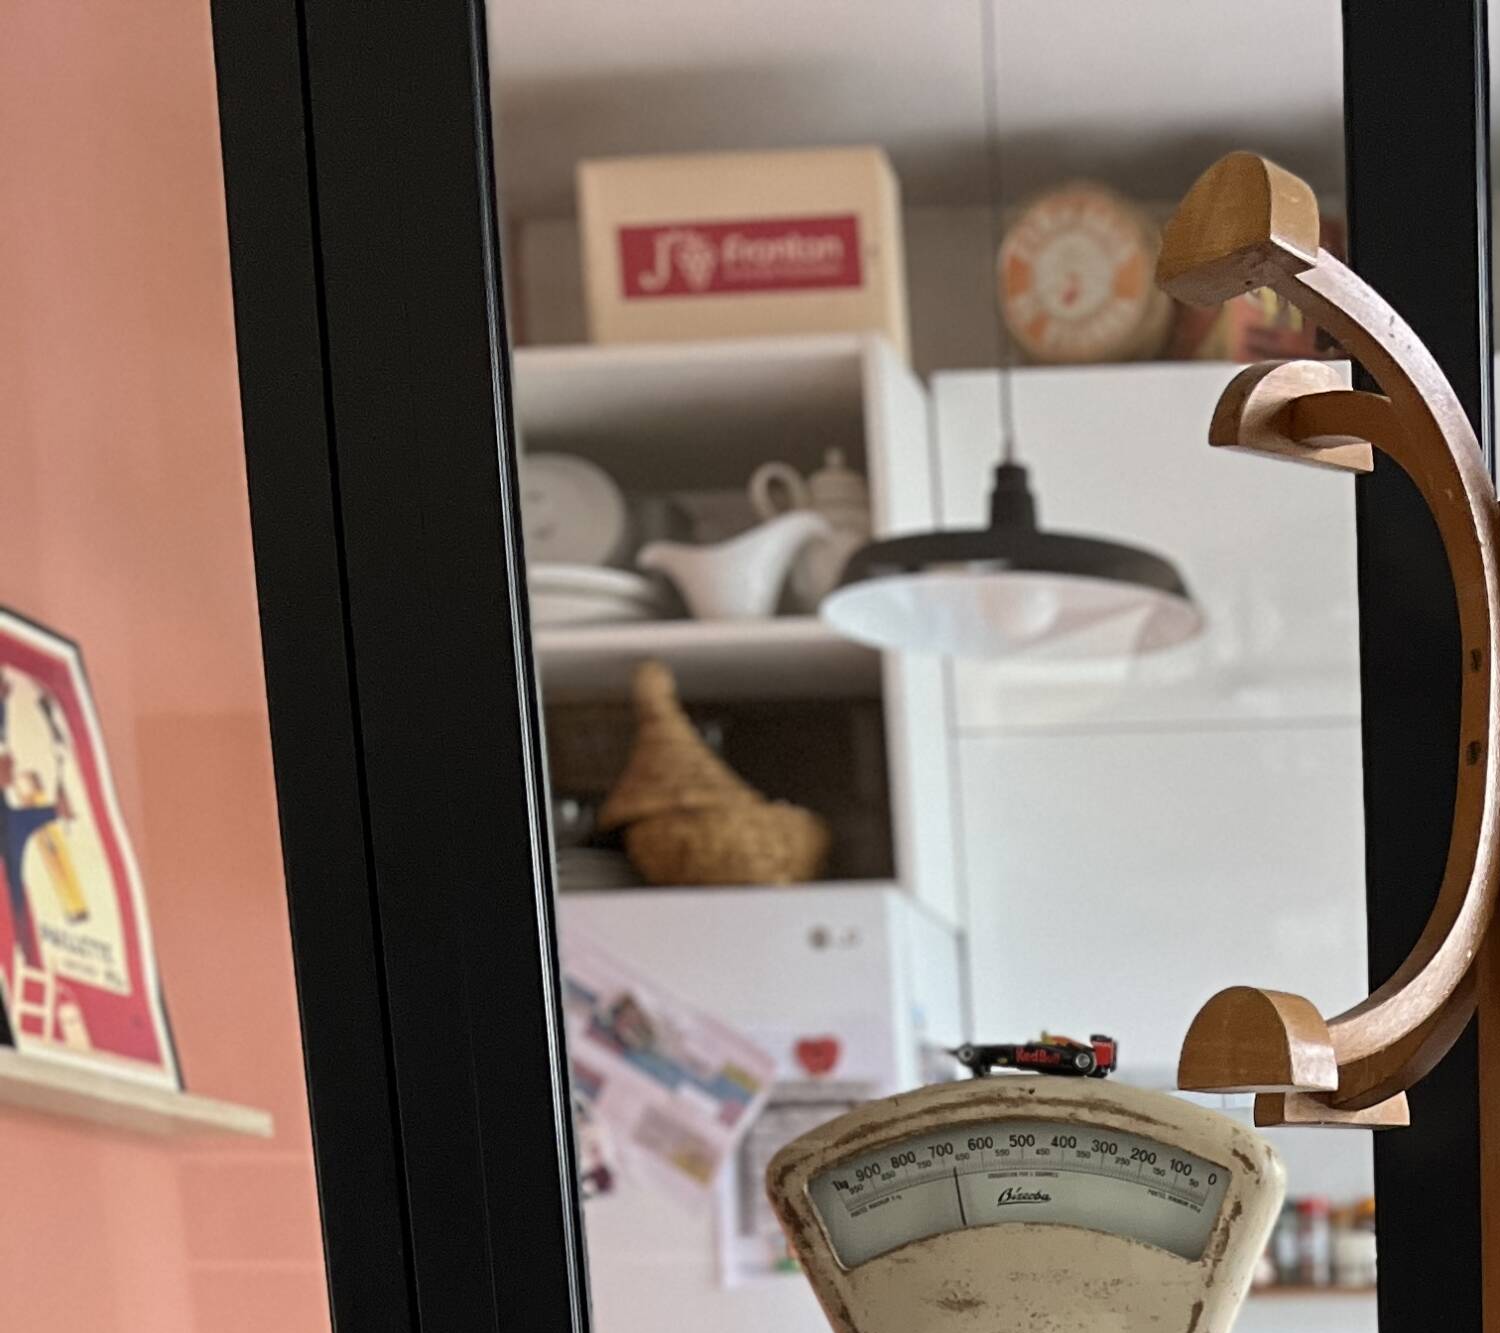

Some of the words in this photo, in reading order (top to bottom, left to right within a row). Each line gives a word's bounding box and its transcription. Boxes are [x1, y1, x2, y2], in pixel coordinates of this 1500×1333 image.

[855, 1162, 881, 1181] 900
[890, 1151, 917, 1169] 800
[927, 1142, 954, 1158] 700
[967, 1136, 994, 1151] 600
[1008, 1134, 1035, 1147] 500
[1050, 1135, 1077, 1149] 400
[1090, 1138, 1118, 1156] 300
[1130, 1147, 1157, 1165] 200
[1169, 1158, 1193, 1176] 100
[1207, 1173, 1218, 1186] 0
[1189, 1178, 1199, 1188] 50
